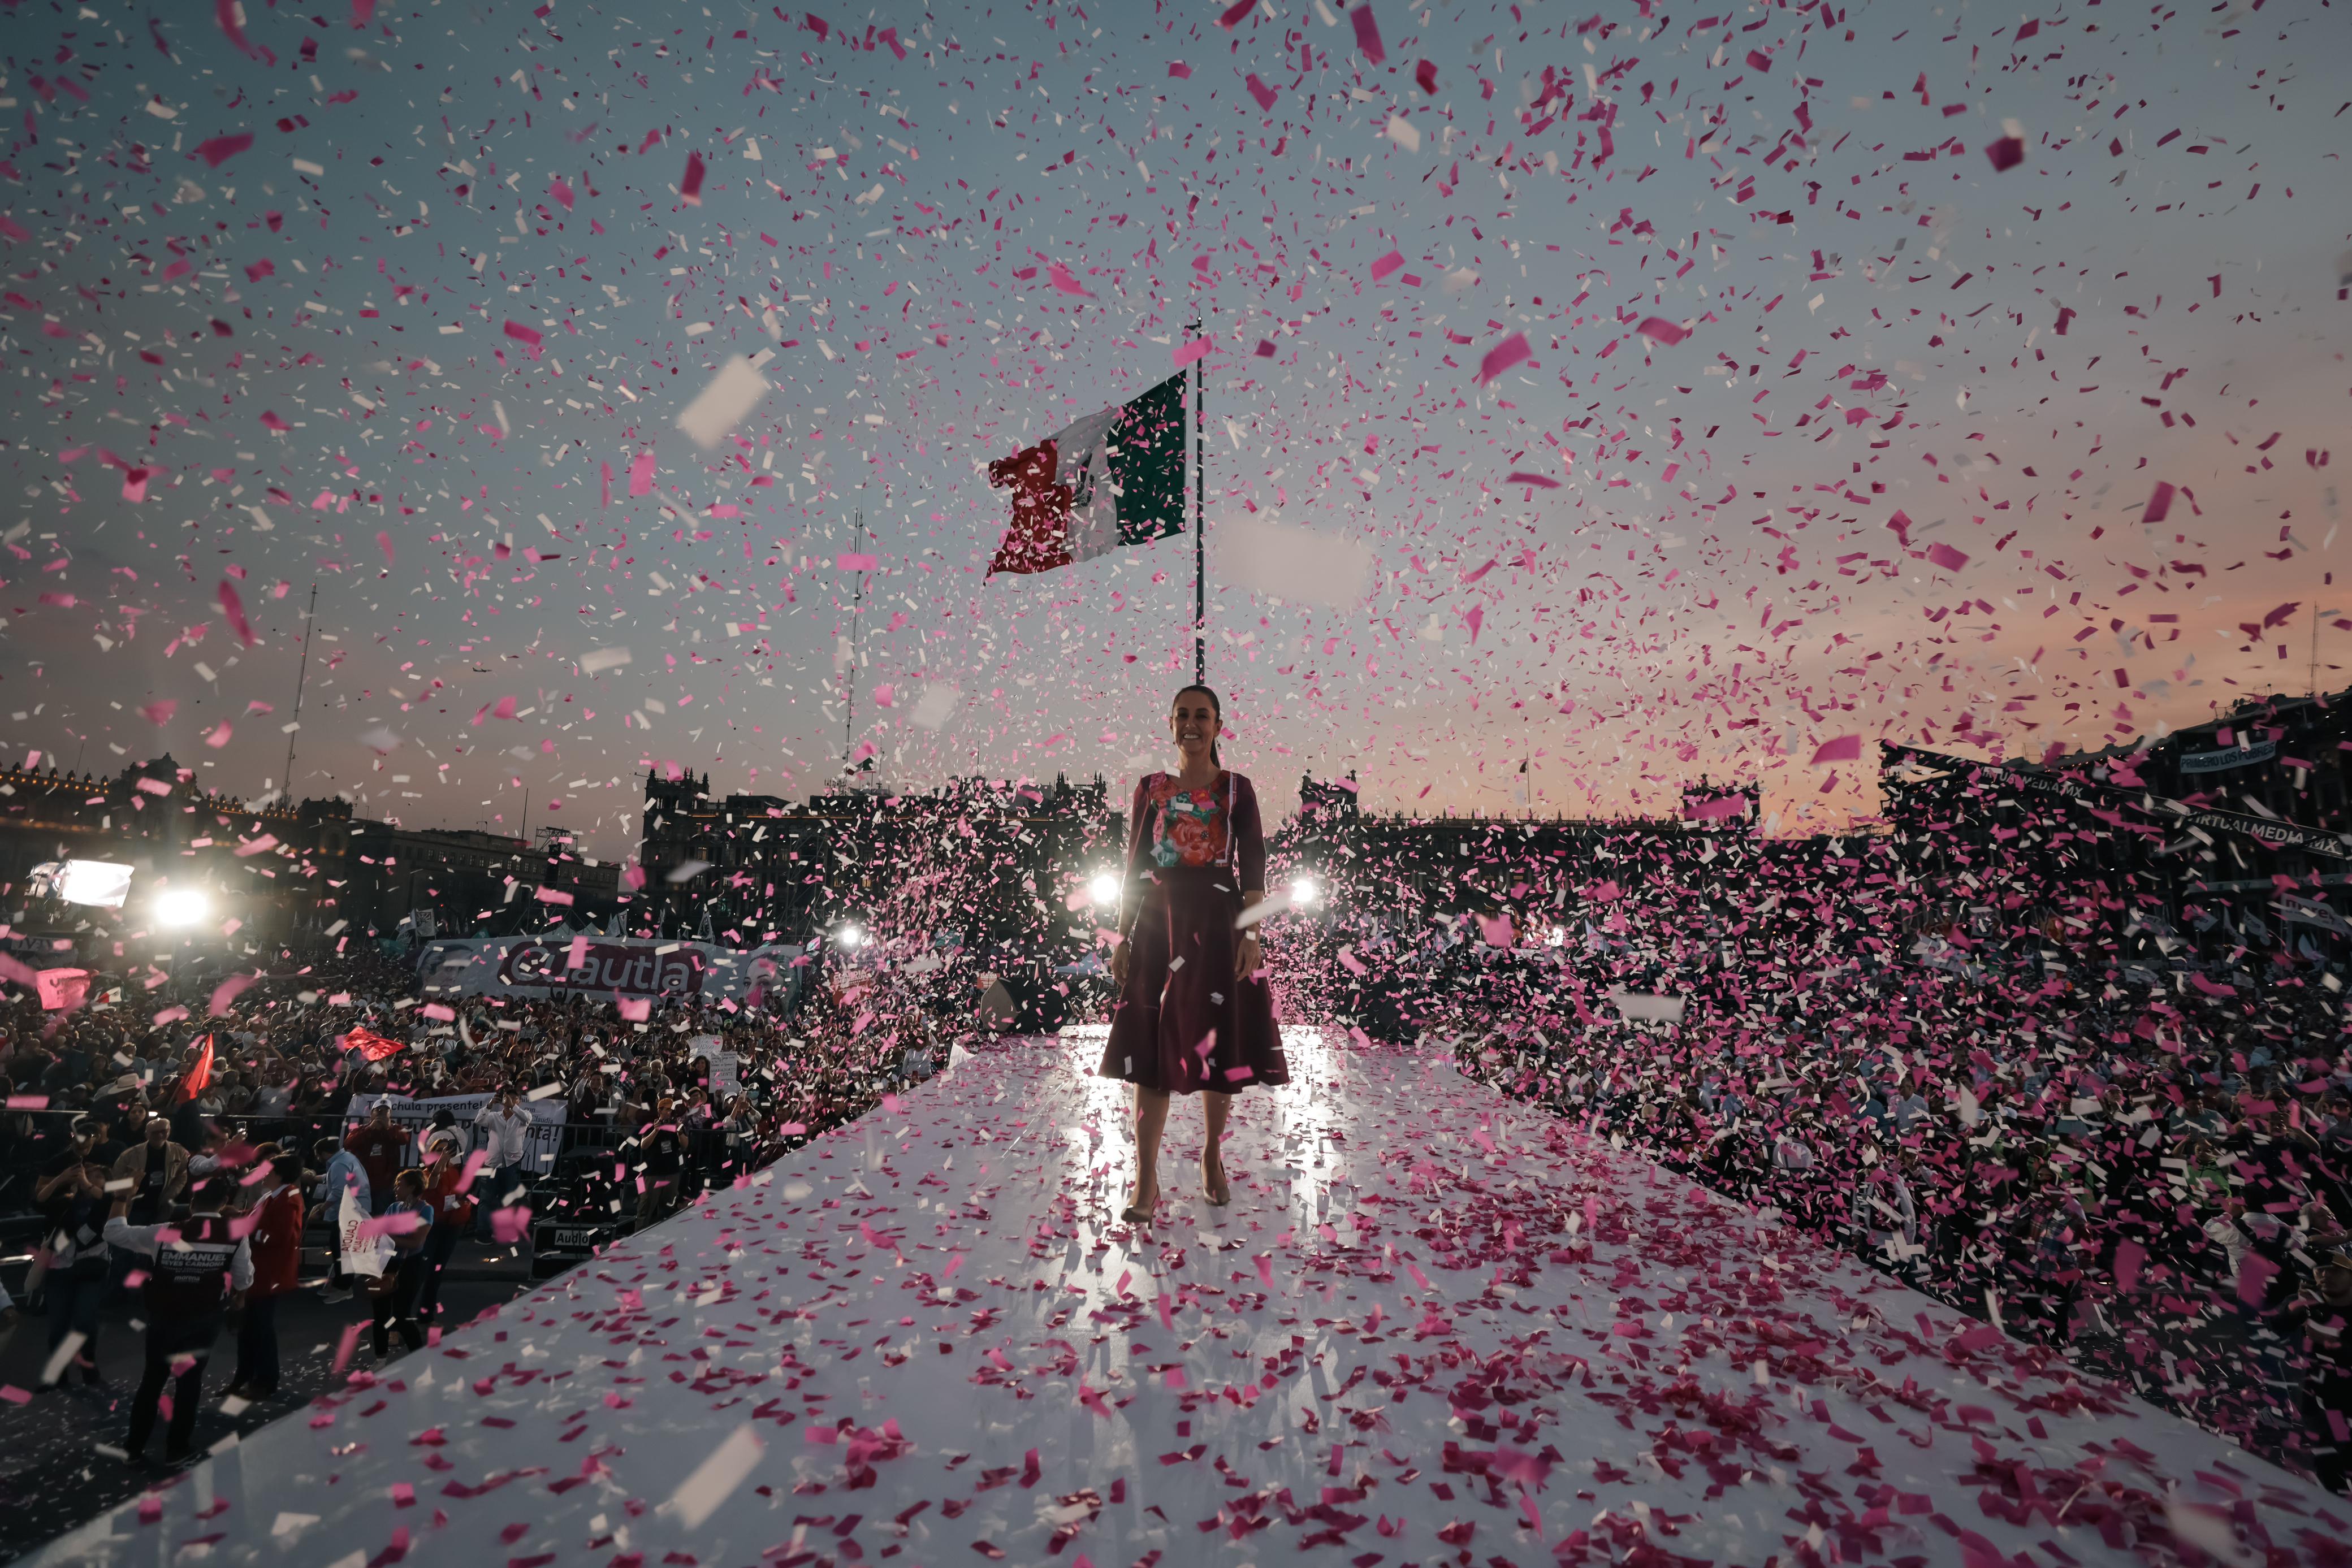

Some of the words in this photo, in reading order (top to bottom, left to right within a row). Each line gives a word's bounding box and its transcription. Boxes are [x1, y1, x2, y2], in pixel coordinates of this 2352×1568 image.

[2220, 751, 2237, 765] LOS
[511, 946, 689, 992] Cuautla
[368, 1101, 421, 1111] Tchula
[427, 1101, 482, 1113] presente!
[556, 1233, 588, 1244] Audio
[162, 1251, 226, 1262] EMMANUEL
